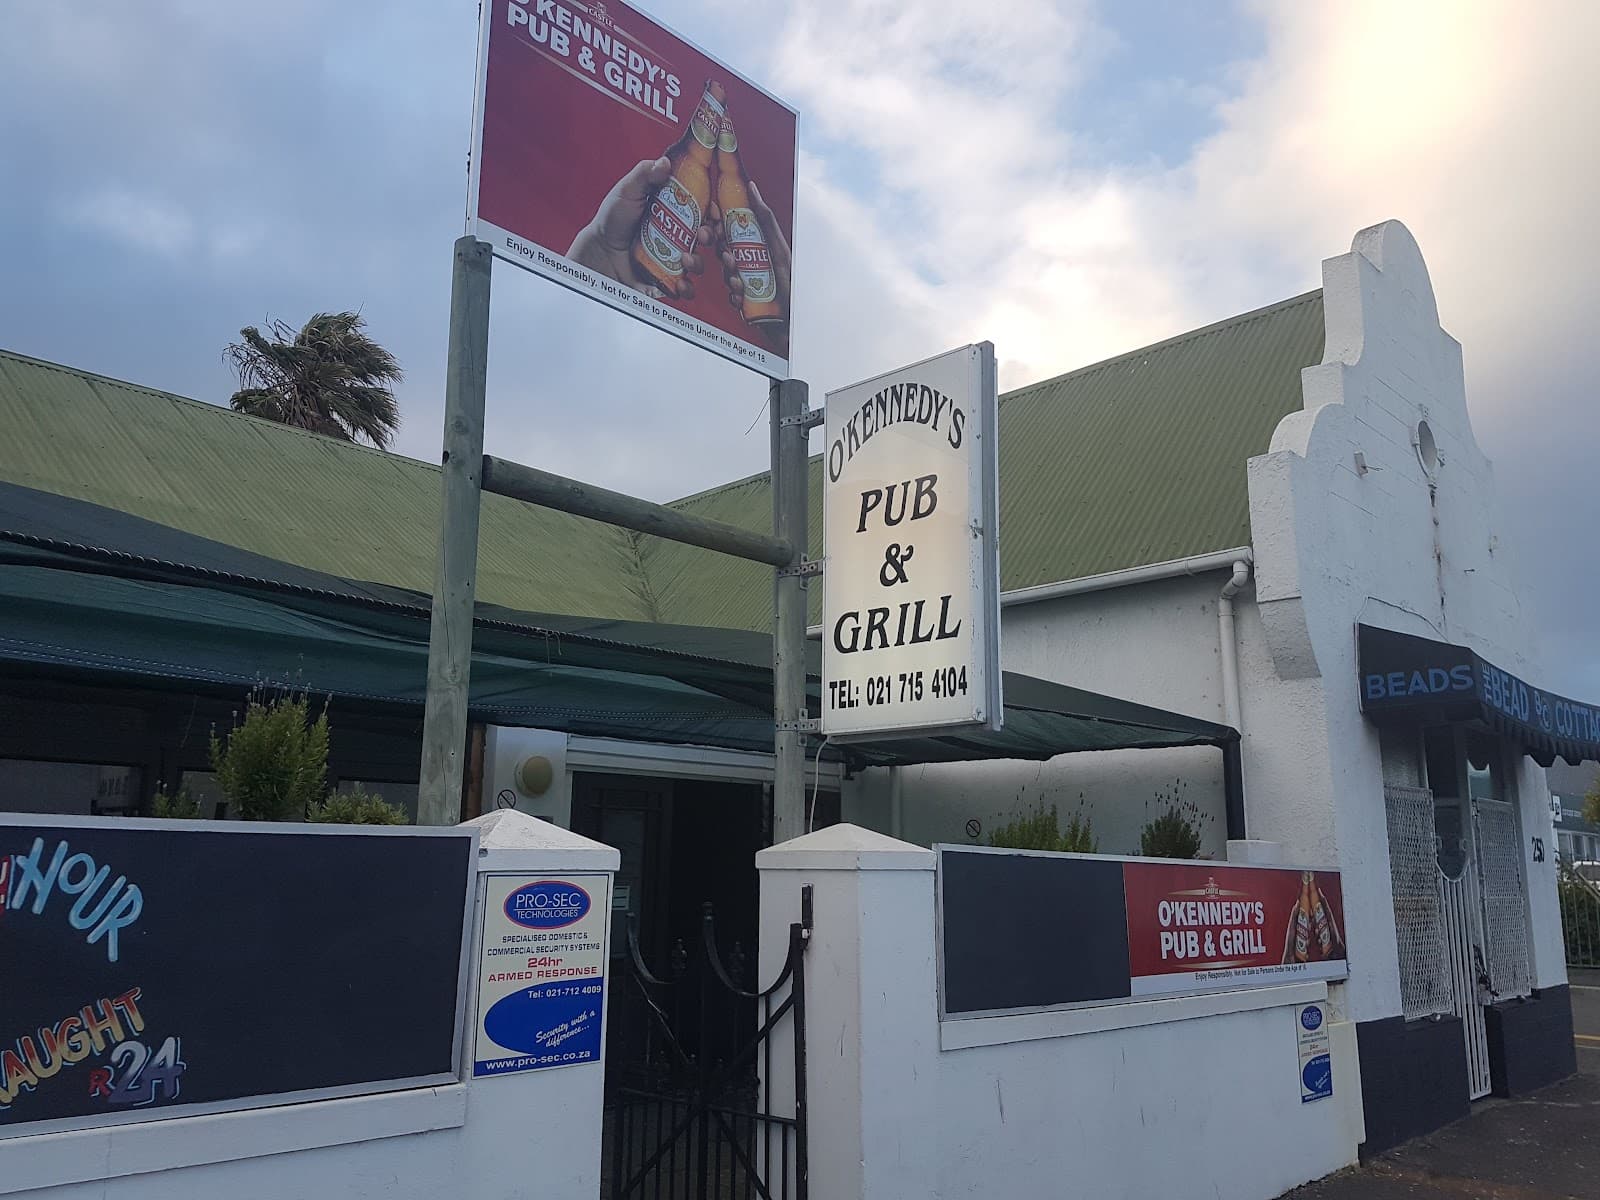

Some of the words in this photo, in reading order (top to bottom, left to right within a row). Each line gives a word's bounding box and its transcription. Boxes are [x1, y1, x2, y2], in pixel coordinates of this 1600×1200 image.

[507, 2, 570, 57] PUB
[577, 46, 596, 74] &
[604, 61, 679, 124] GRILL
[650, 202, 692, 247] CASTLE
[733, 248, 769, 262] CASTLE
[506, 237, 535, 259] Enjoy
[601, 280, 617, 296] Not
[618, 288, 631, 301] for
[632, 295, 650, 311] Sale
[652, 303, 660, 316] to
[662, 309, 695, 331] Persons
[696, 324, 719, 342] Under
[720, 336, 732, 348] the
[732, 341, 747, 356] Age
[748, 349, 756, 358] of
[828, 382, 966, 483] O'KENNEDY'S
[856, 474, 938, 533] PUB
[879, 543, 914, 587] &
[833, 595, 962, 654] GRILL
[829, 678, 859, 710] TEL:
[866, 675, 892, 706] 021
[899, 671, 923, 703] 715
[931, 665, 968, 699] 4104
[1365, 664, 1474, 700] BEADS
[1482, 662, 1492, 704] THE
[1491, 667, 1530, 722] BEAD
[11, 837, 143, 962] HOUR
[516, 893, 581, 908] PRO-SEC
[517, 909, 579, 919] TECHNOLOGIES
[1158, 900, 1265, 927] O'KENNEDY'S
[487, 946, 535, 956] COMMERCIAL
[535, 944, 569, 954] SECURITY
[569, 942, 600, 951] SYSTEMS
[502, 934, 547, 943] SPECIALISED
[1160, 930, 1200, 960] PUB
[1204, 929, 1217, 957] &
[1220, 928, 1267, 956] GRILL
[488, 971, 533, 982] ARMED
[537, 966, 598, 978] RESPONSE
[527, 956, 563, 968] 24hr
[527, 990, 544, 999] Tel:
[546, 987, 580, 997] 021-712
[535, 1020, 568, 1044] Security
[570, 1011, 588, 1027] with
[486, 1050, 591, 1070] www.pro-sec.co.za
